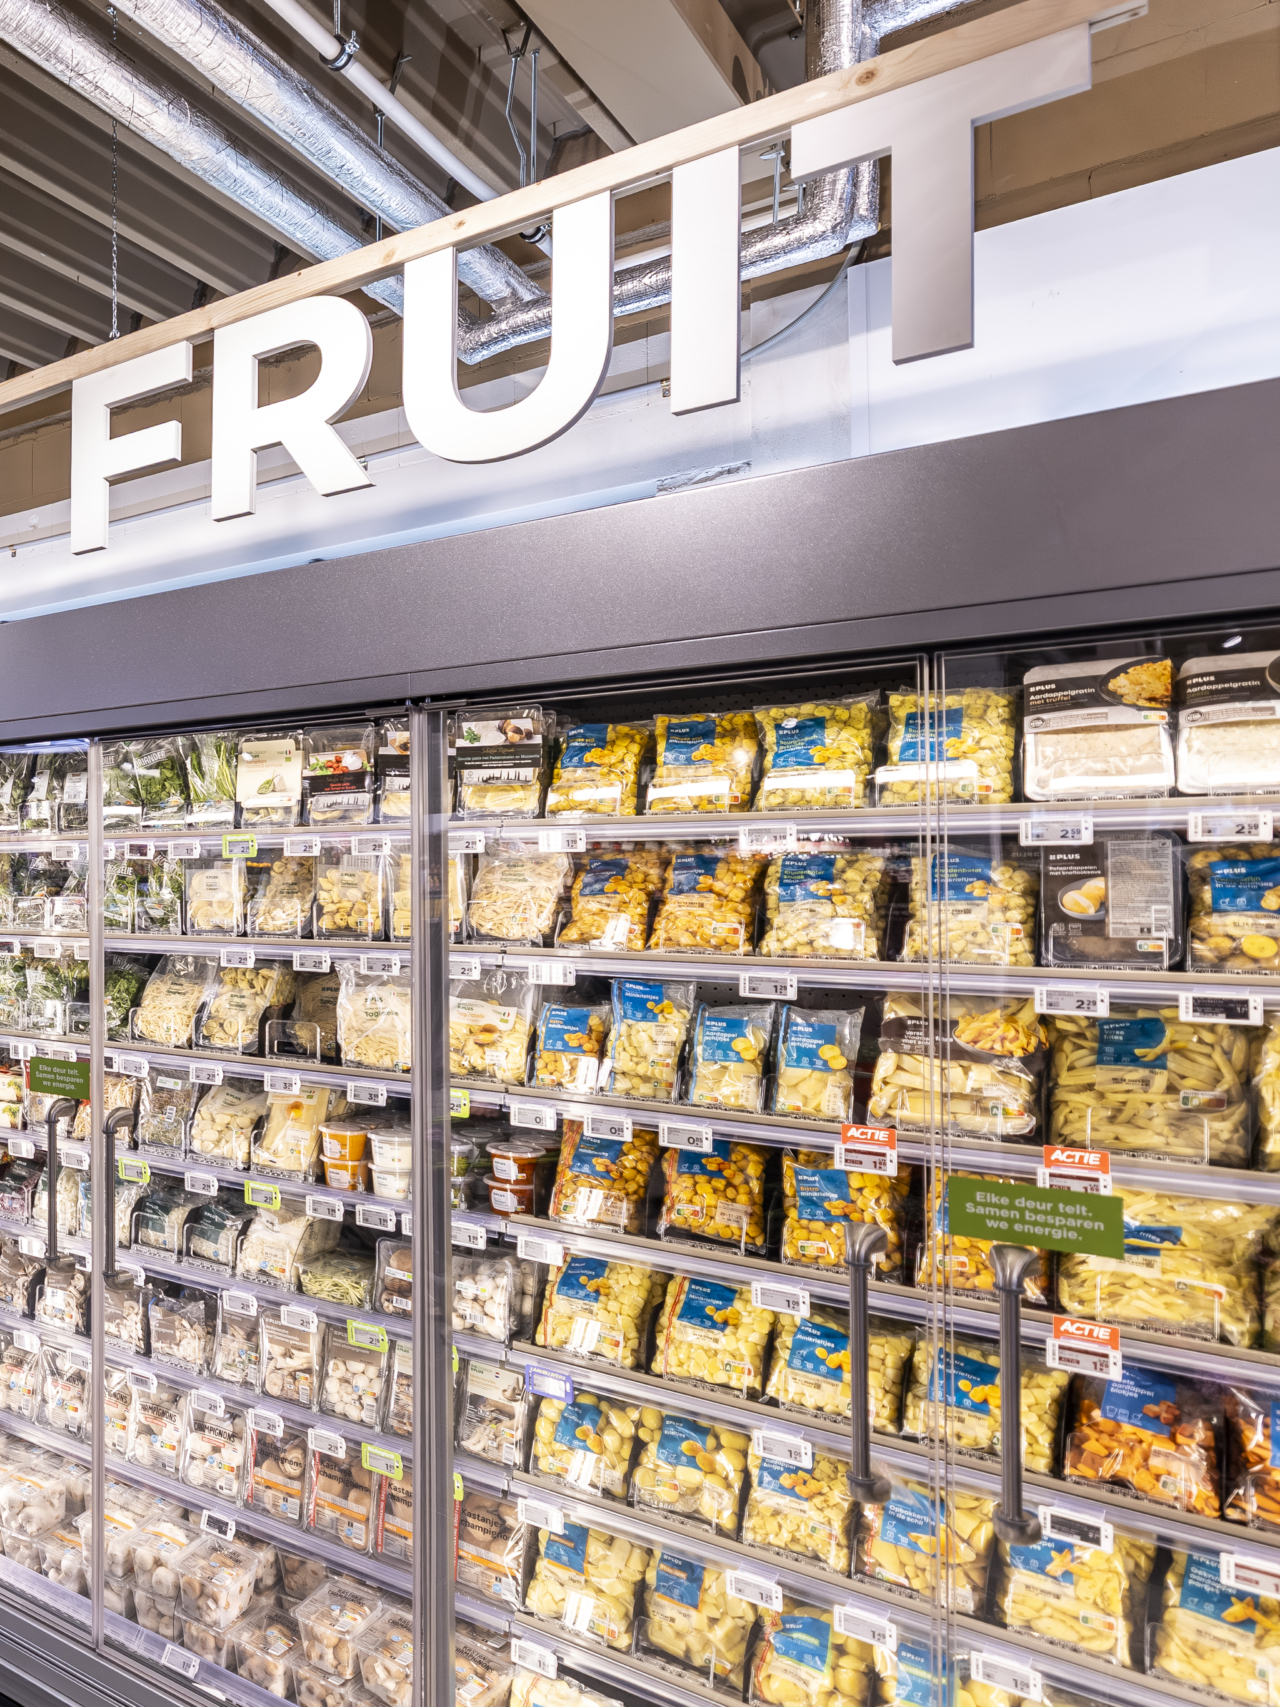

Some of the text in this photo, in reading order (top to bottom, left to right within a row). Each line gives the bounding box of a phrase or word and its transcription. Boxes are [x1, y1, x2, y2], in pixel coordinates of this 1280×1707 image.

[69, 23, 1093, 555] FRUIT
[1034, 683, 1057, 692] PLUS
[1186, 679, 1262, 694] Aardappelgratin
[1193, 675, 1216, 684] PLUS
[1029, 687, 1096, 701] Aardappelgratin
[1056, 853, 1081, 861] PLUS
[790, 1036, 825, 1044] Aardappel
[35, 1071, 84, 1084] Samen besparen
[39, 1064, 80, 1076] Elke deur telt.
[52, 1081, 76, 1091] energie.
[846, 1126, 890, 1142] ACTIE
[1050, 1149, 1101, 1166] ACTIE
[975, 1190, 1093, 1217] Elke deur telt.
[965, 1202, 1105, 1232] Samen besparen
[985, 1218, 1083, 1242] we energie.
[688, 1293, 723, 1306] Minikrieltjes
[1059, 1320, 1112, 1341] ACTIE
[795, 1333, 835, 1349] Minikrieltjes
[193, 1420, 236, 1444] CHAMPIGNONS
[320, 1459, 353, 1477] Kastanje
[319, 1469, 371, 1492] champignons
[460, 1507, 500, 1528] Kastanje
